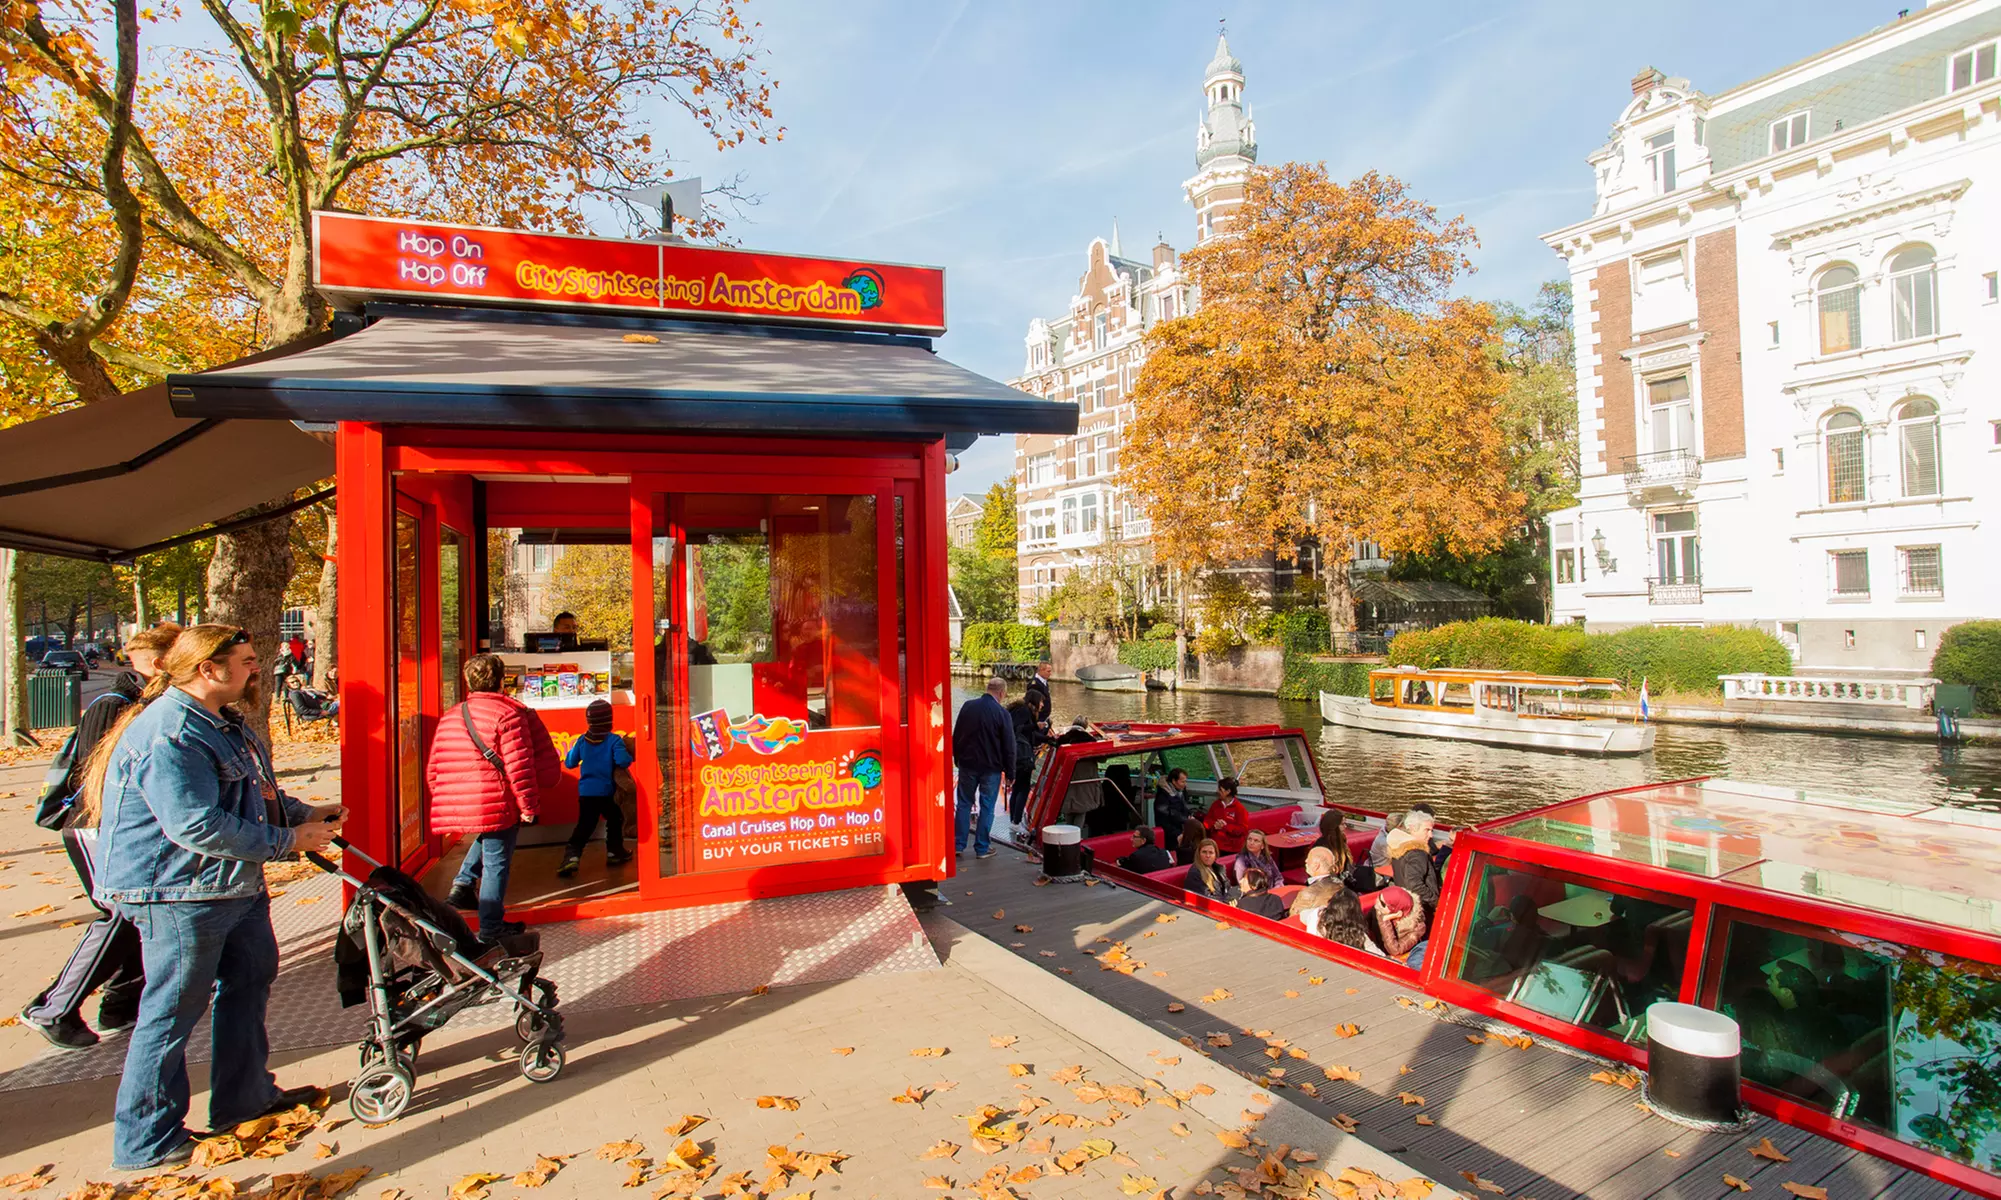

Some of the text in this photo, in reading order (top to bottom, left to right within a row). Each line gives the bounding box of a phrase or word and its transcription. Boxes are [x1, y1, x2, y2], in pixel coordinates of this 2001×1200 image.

[400, 232, 483, 259] Hop On
[401, 260, 488, 287] Hop Off
[709, 272, 861, 315] Amsterdam
[701, 778, 864, 816] Amsterdam
[702, 823, 736, 839] Canal
[740, 819, 786, 834] Cruises
[790, 815, 814, 832] Hop
[818, 813, 836, 827] On
[846, 810, 870, 827] Hop
[703, 847, 734, 860] BUY
[740, 841, 783, 856] YOUR
[788, 835, 849, 851] TICKETS
